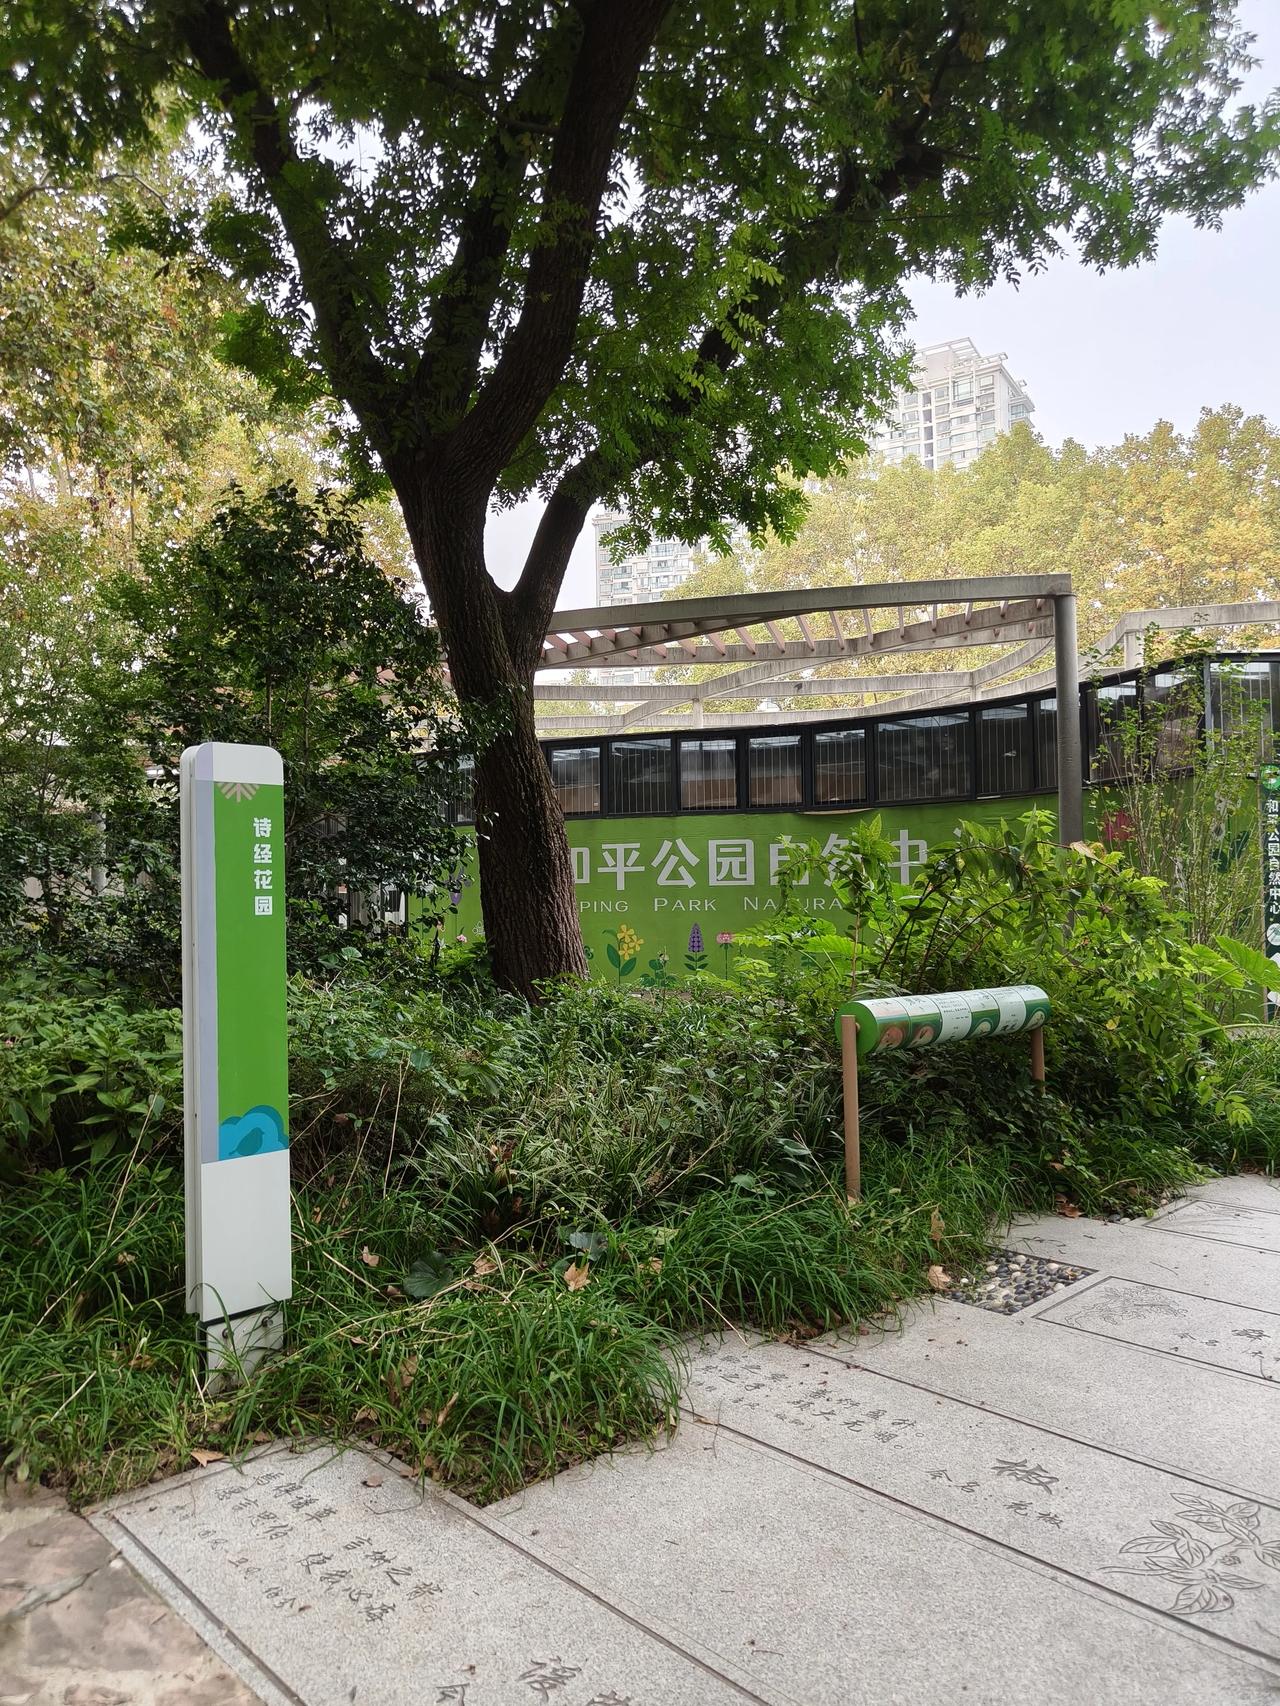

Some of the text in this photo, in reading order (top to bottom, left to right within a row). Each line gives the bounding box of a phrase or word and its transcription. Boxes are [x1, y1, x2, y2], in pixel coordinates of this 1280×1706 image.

[253, 817, 273, 916] 诗经花园
[580, 900, 629, 913] PING
[654, 897, 717, 912] PARK
